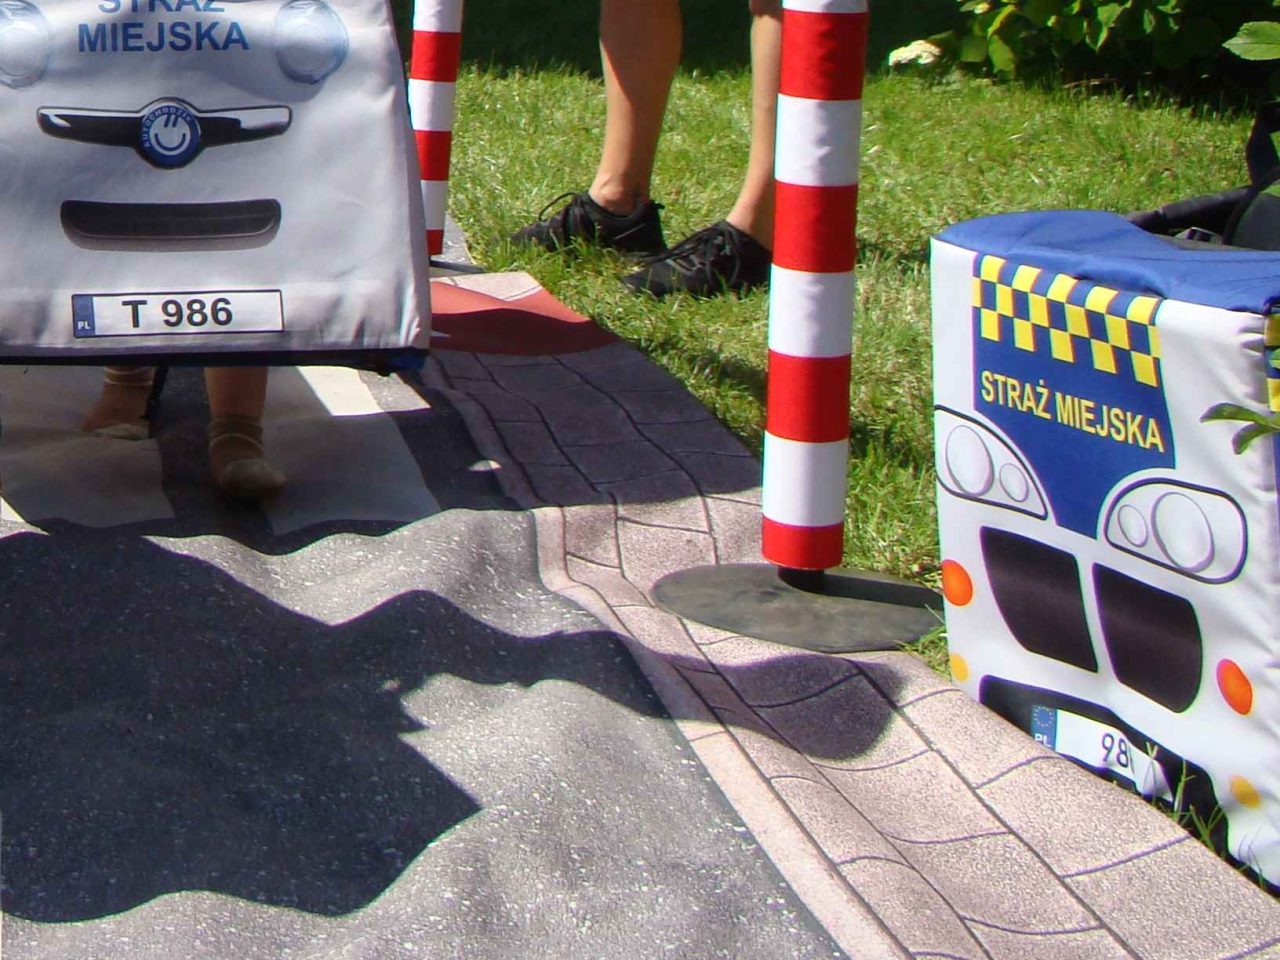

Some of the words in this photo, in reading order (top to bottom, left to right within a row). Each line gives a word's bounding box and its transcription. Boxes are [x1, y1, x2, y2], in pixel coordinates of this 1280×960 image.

[78, 21, 250, 52] MIEJSKA
[77, 321, 91, 330] PL
[122, 299, 148, 328] T
[161, 297, 233, 327] 986
[980, 370, 1052, 420] STRAŻ
[1054, 391, 1166, 454] MIEJSKA
